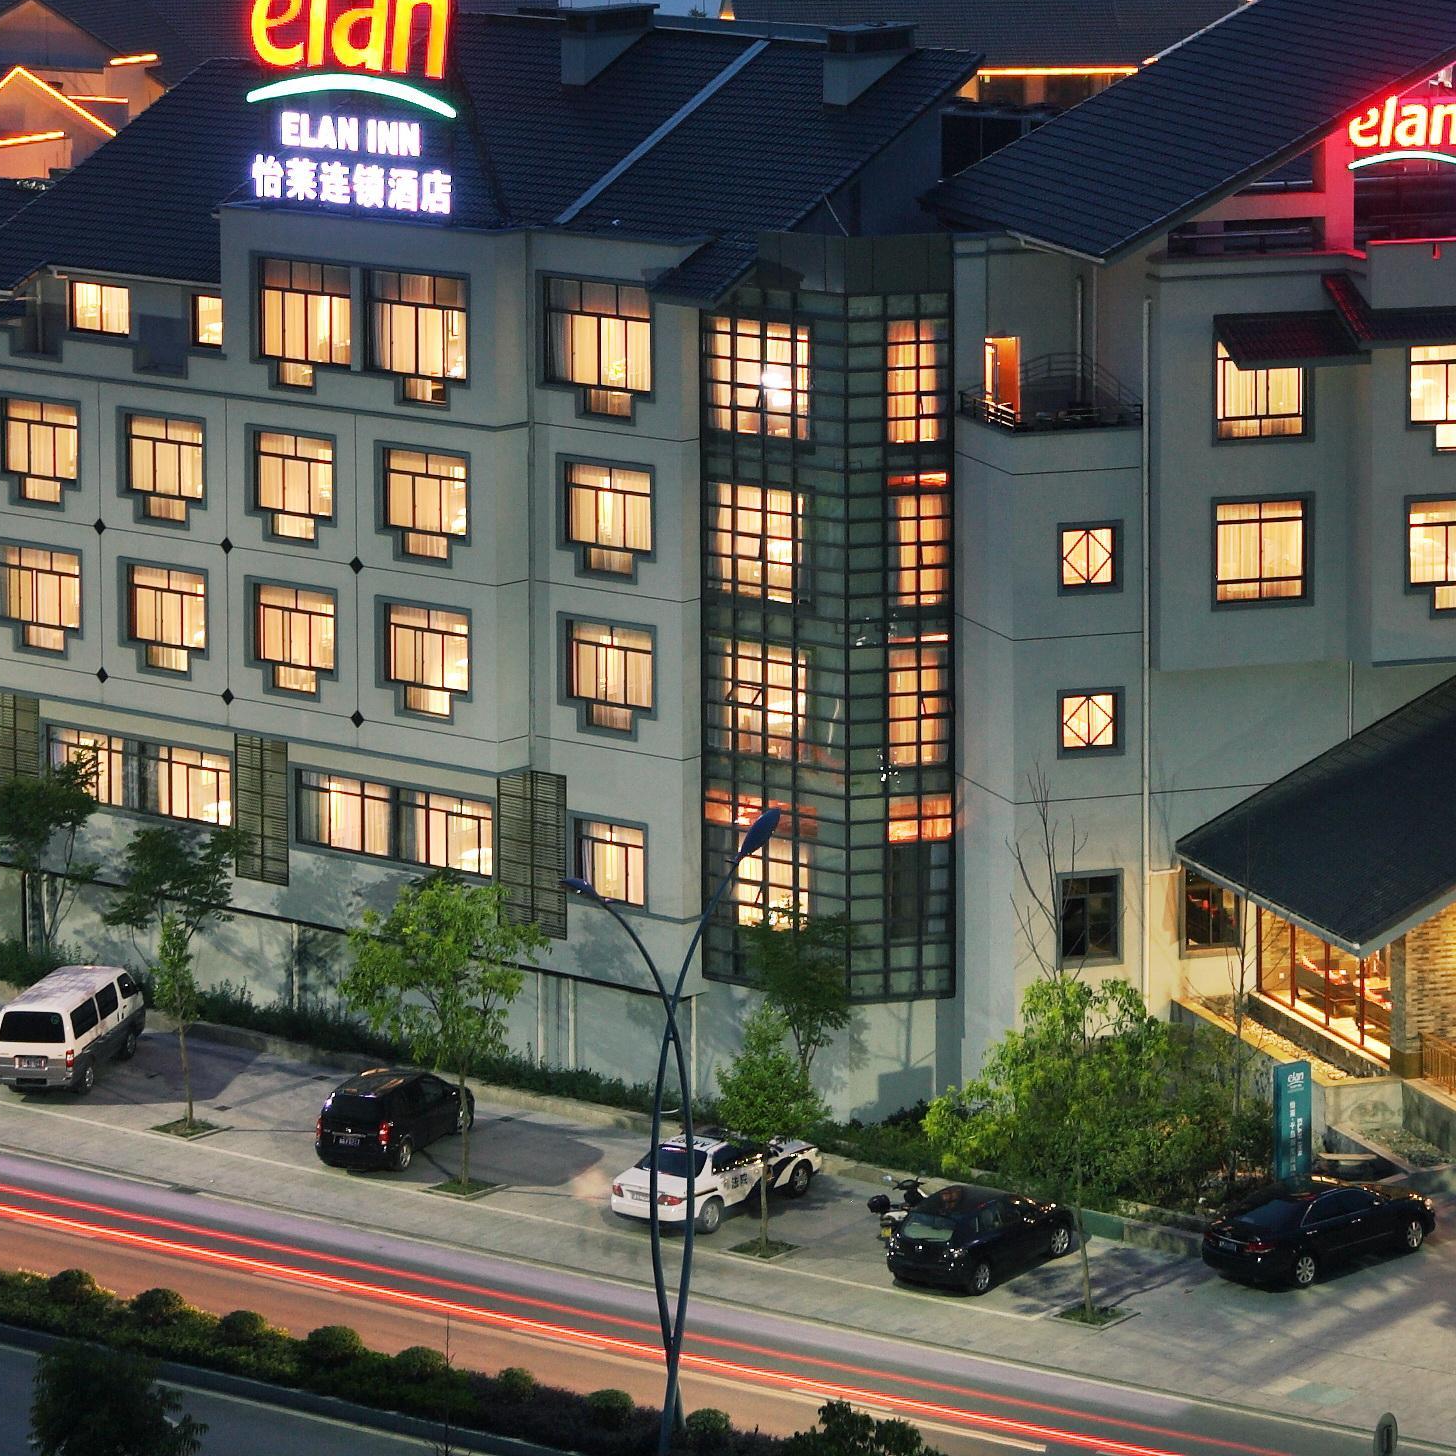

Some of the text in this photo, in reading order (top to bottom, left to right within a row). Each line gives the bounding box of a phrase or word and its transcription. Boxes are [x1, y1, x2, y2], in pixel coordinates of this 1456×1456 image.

[280, 111, 422, 157] ELAN INN
[251, 154, 452, 214] 怡莱连锁酒店
